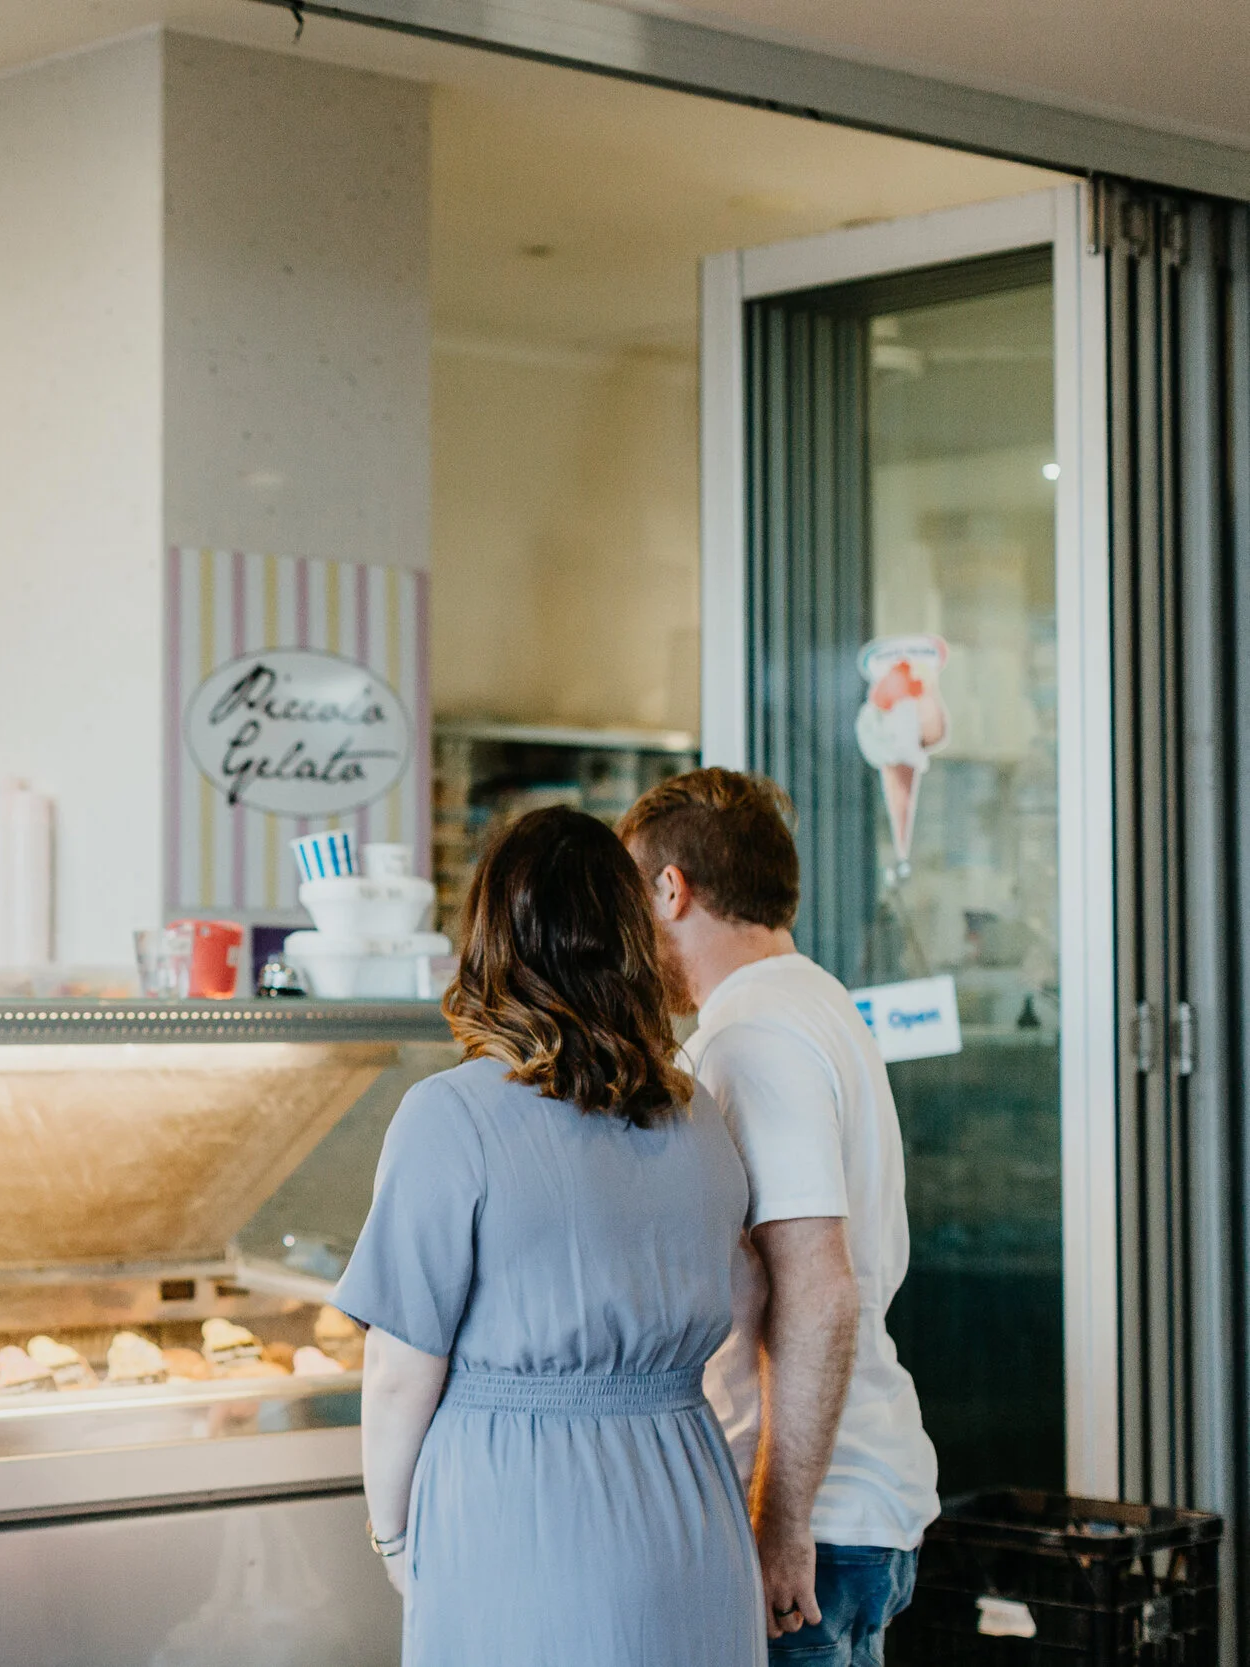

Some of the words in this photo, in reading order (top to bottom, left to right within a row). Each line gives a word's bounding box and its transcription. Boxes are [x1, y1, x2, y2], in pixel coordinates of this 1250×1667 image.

[209, 662, 388, 726] Piccolo
[222, 718, 401, 806] Gelato
[888, 1008, 941, 1031] Open
